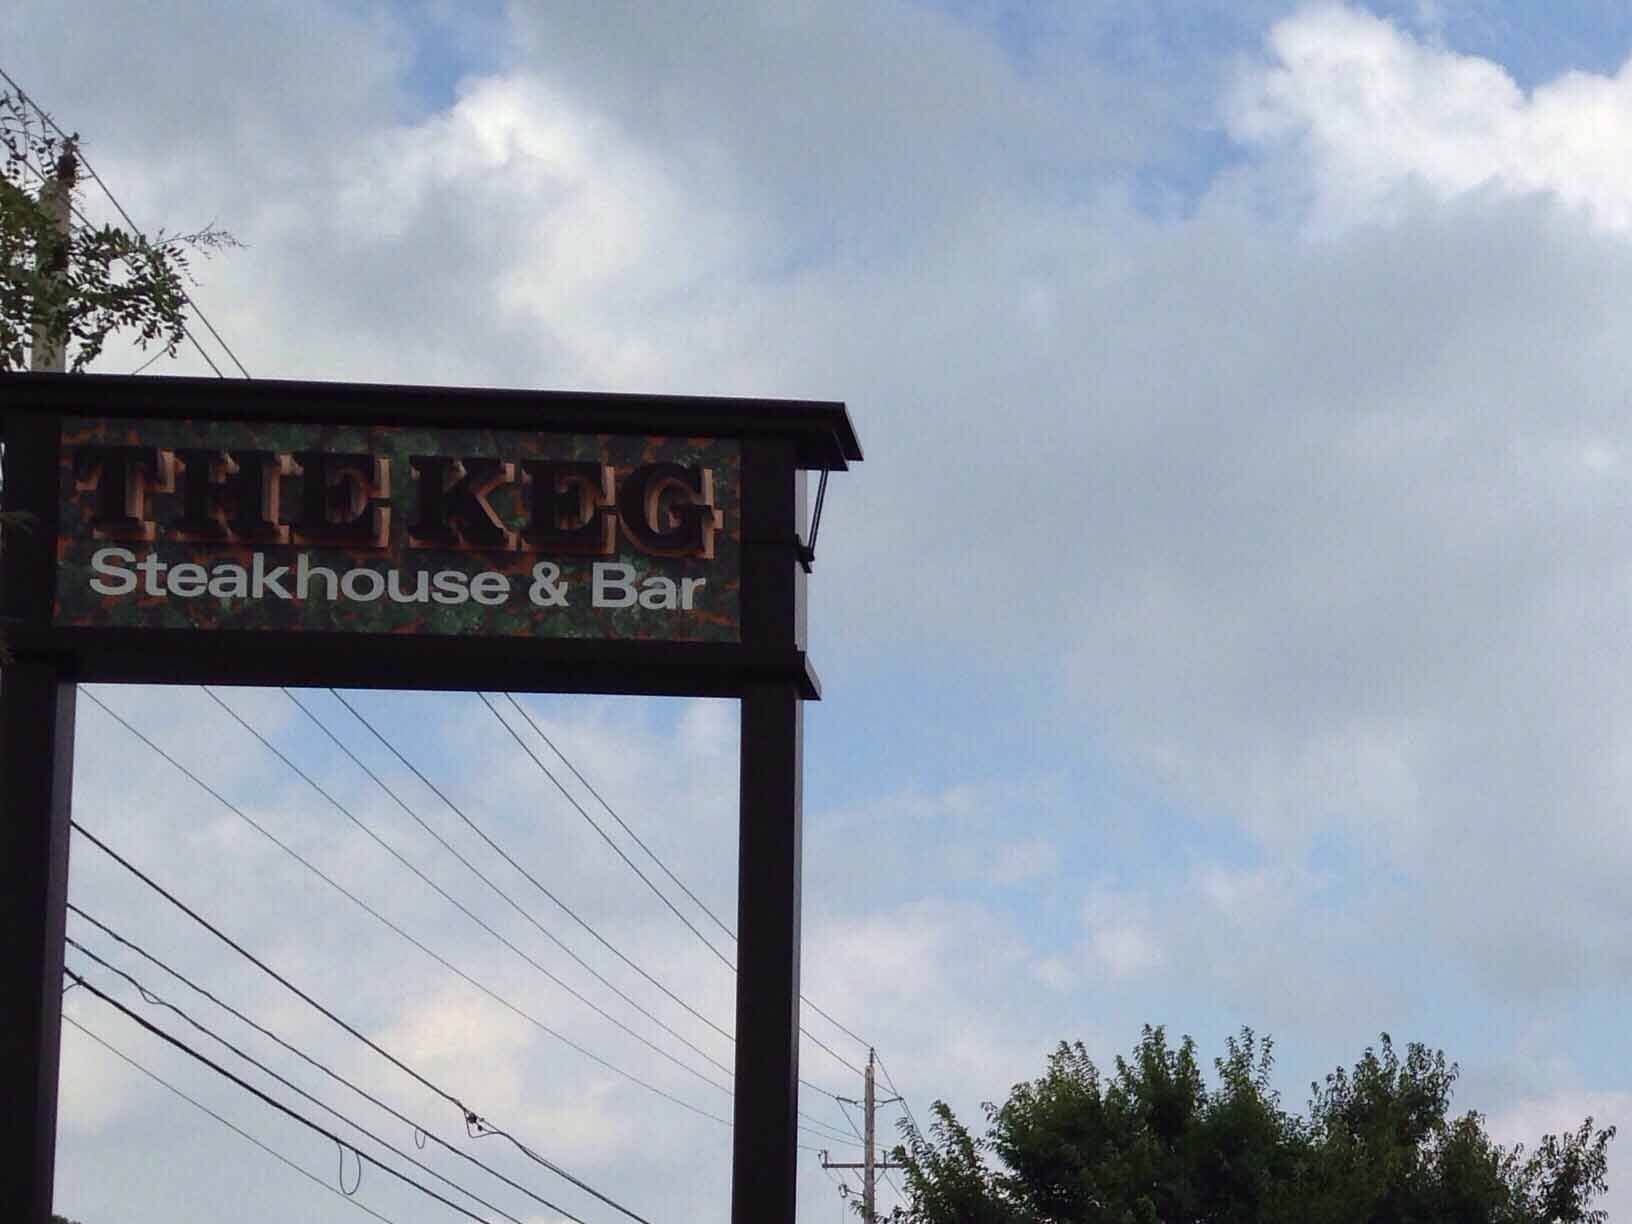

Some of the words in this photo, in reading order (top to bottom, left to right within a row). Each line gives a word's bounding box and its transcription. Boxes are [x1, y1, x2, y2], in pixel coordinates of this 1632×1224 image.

[75, 447, 392, 549] THE
[408, 455, 724, 559] KEG
[89, 547, 511, 606] Steakhouse
[528, 561, 569, 608] &
[591, 562, 706, 610] Bar
